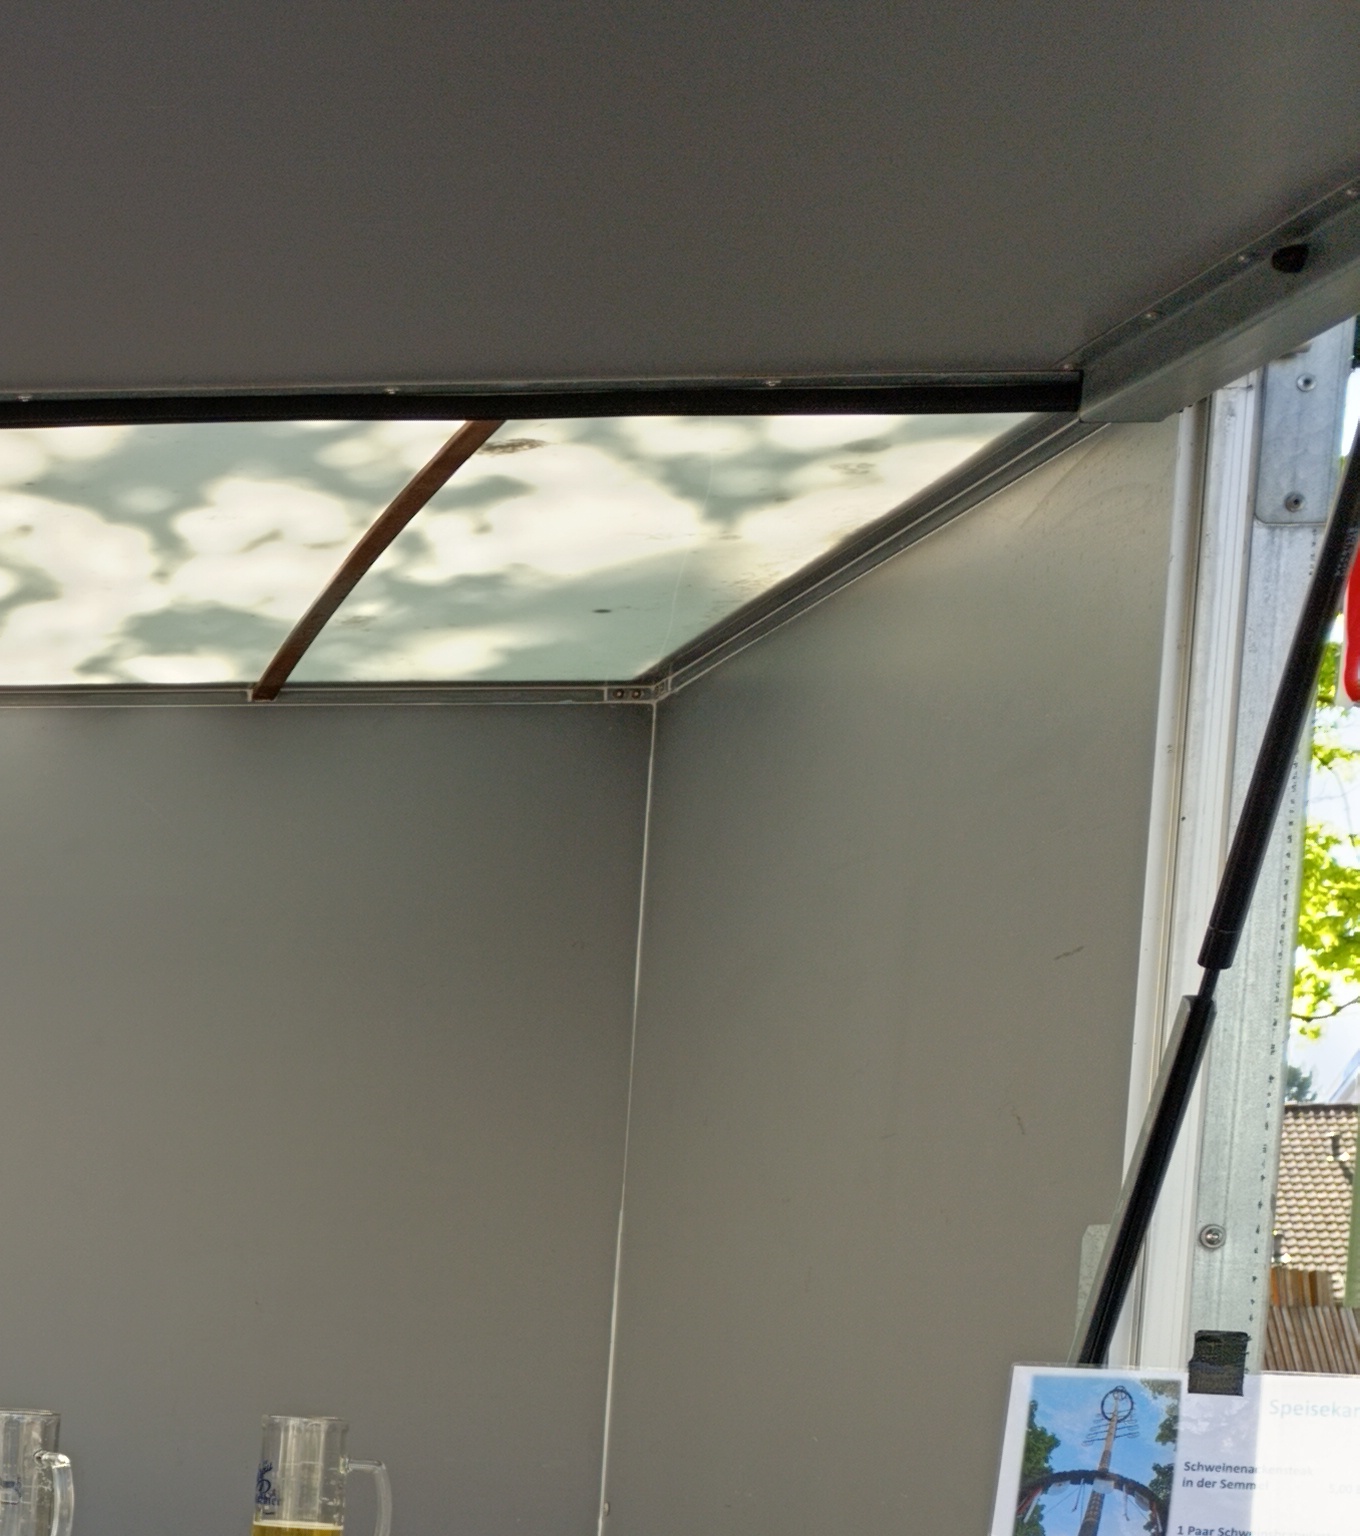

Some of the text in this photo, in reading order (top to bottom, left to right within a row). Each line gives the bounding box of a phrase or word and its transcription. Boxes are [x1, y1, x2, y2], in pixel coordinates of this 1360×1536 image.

[1182, 1478, 1192, 1488] in
[1195, 1478, 1216, 1489] der
[1219, 1478, 1268, 1490] Semmel
[1178, 1526, 1183, 1535] 1
[1188, 1526, 1213, 1536] Paar
